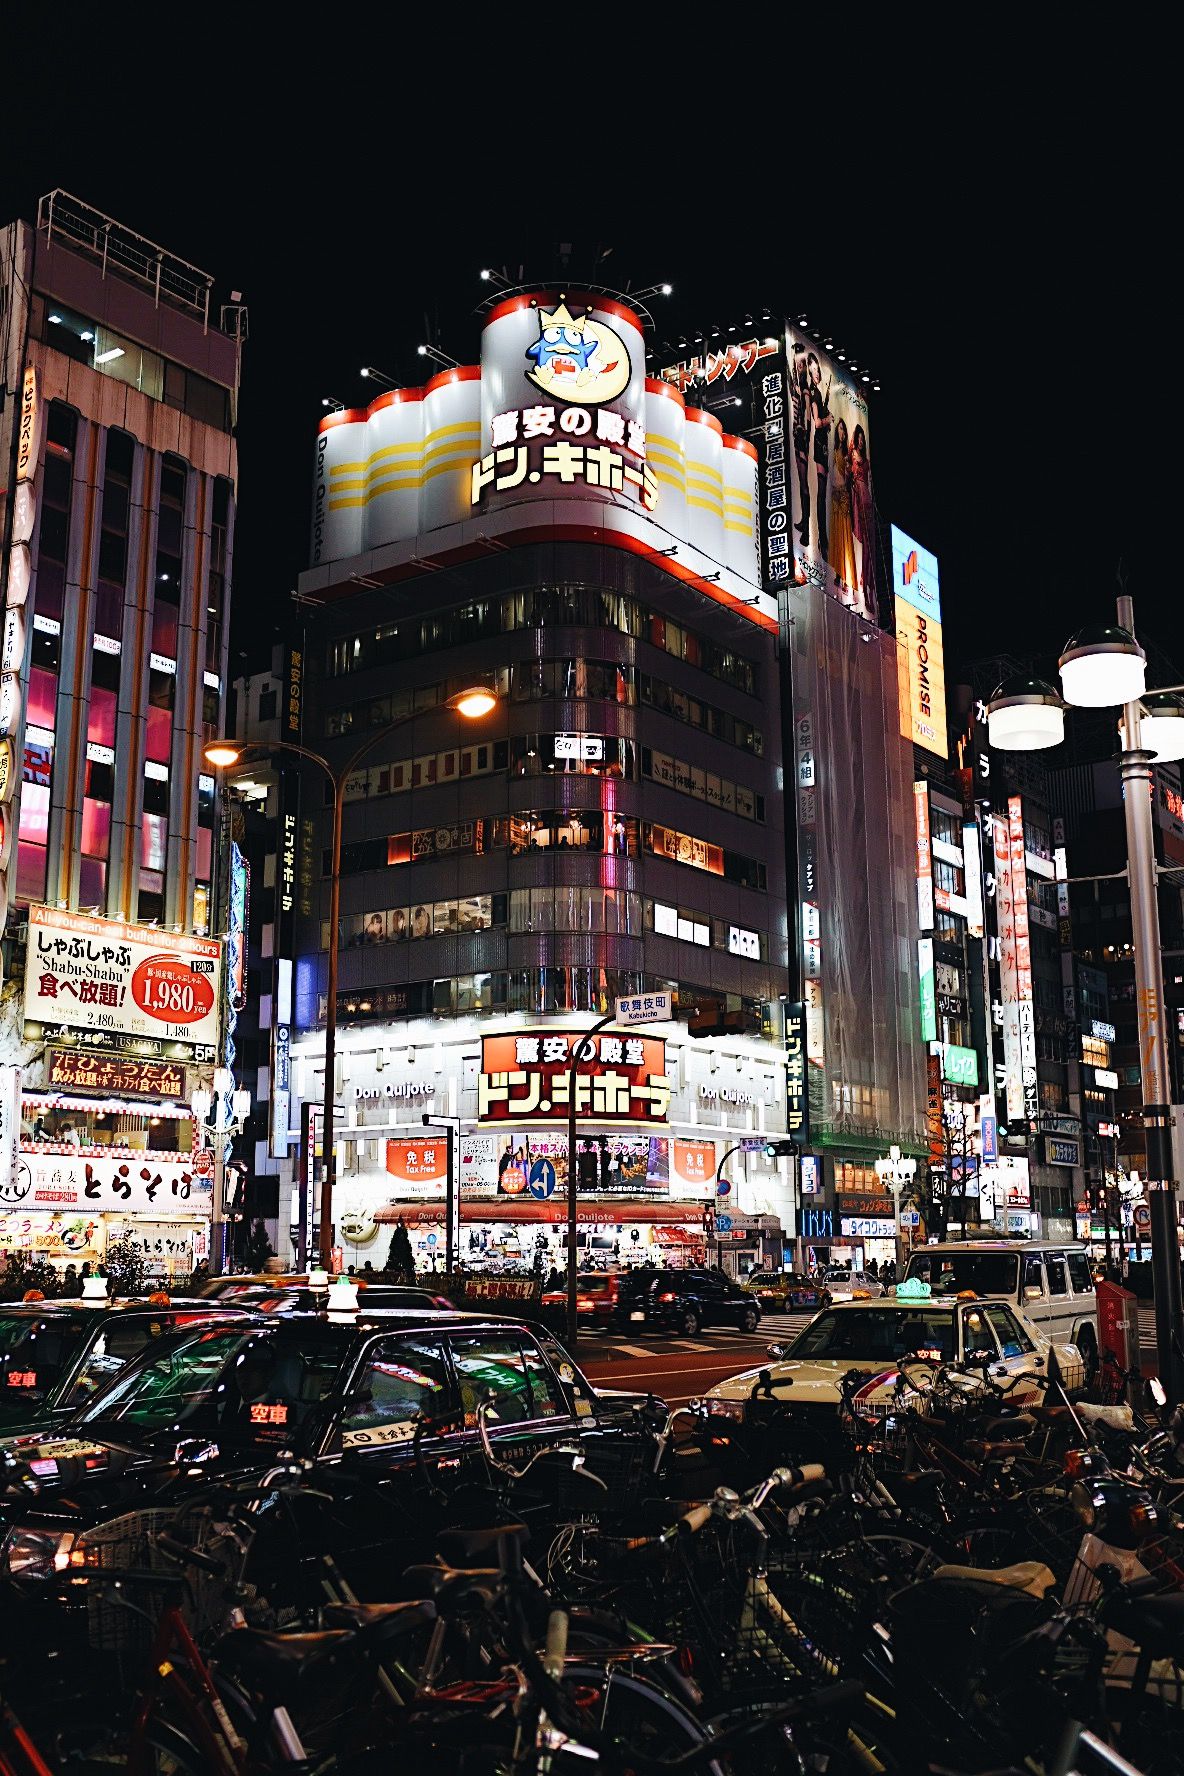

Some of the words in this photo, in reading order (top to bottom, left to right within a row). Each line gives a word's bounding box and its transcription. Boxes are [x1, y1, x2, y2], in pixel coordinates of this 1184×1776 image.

[491, 405, 646, 461] 驚安の殿堂
[317, 436, 328, 480] Don
[314, 483, 327, 562] Quijote
[916, 614, 932, 718] PROMISE
[37, 931, 132, 967] しゃぶしゃぶ
[190, 938, 218, 956] hours
[193, 962, 213, 973] 120分
[142, 979, 194, 1014] 1,980
[194, 1004, 207, 1015] yen
[619, 996, 666, 1014] 歌舞伎町
[87, 1012, 114, 1028] 2,480
[628, 1011, 658, 1020] Kabukicho
[166, 1023, 189, 1037] 1,480
[515, 1036, 645, 1065] 驚安の殿堂
[54, 1053, 74, 1068] 7F
[78, 1055, 181, 1081] ひょうたん
[951, 1054, 975, 1077] レイク
[353, 1085, 379, 1099] Don
[383, 1082, 435, 1101] Quijote
[700, 1084, 718, 1100] Don
[985, 1120, 993, 1153] PROMISE
[406, 1150, 436, 1165] 免税
[406, 1166, 419, 1174] Tax
[420, 1165, 436, 1173] Free
[84, 1162, 193, 1203] とらそば
[577, 1213, 615, 1223] Quijote
[8, 1371, 37, 1388] 空車
[250, 1403, 289, 1425] 空車
